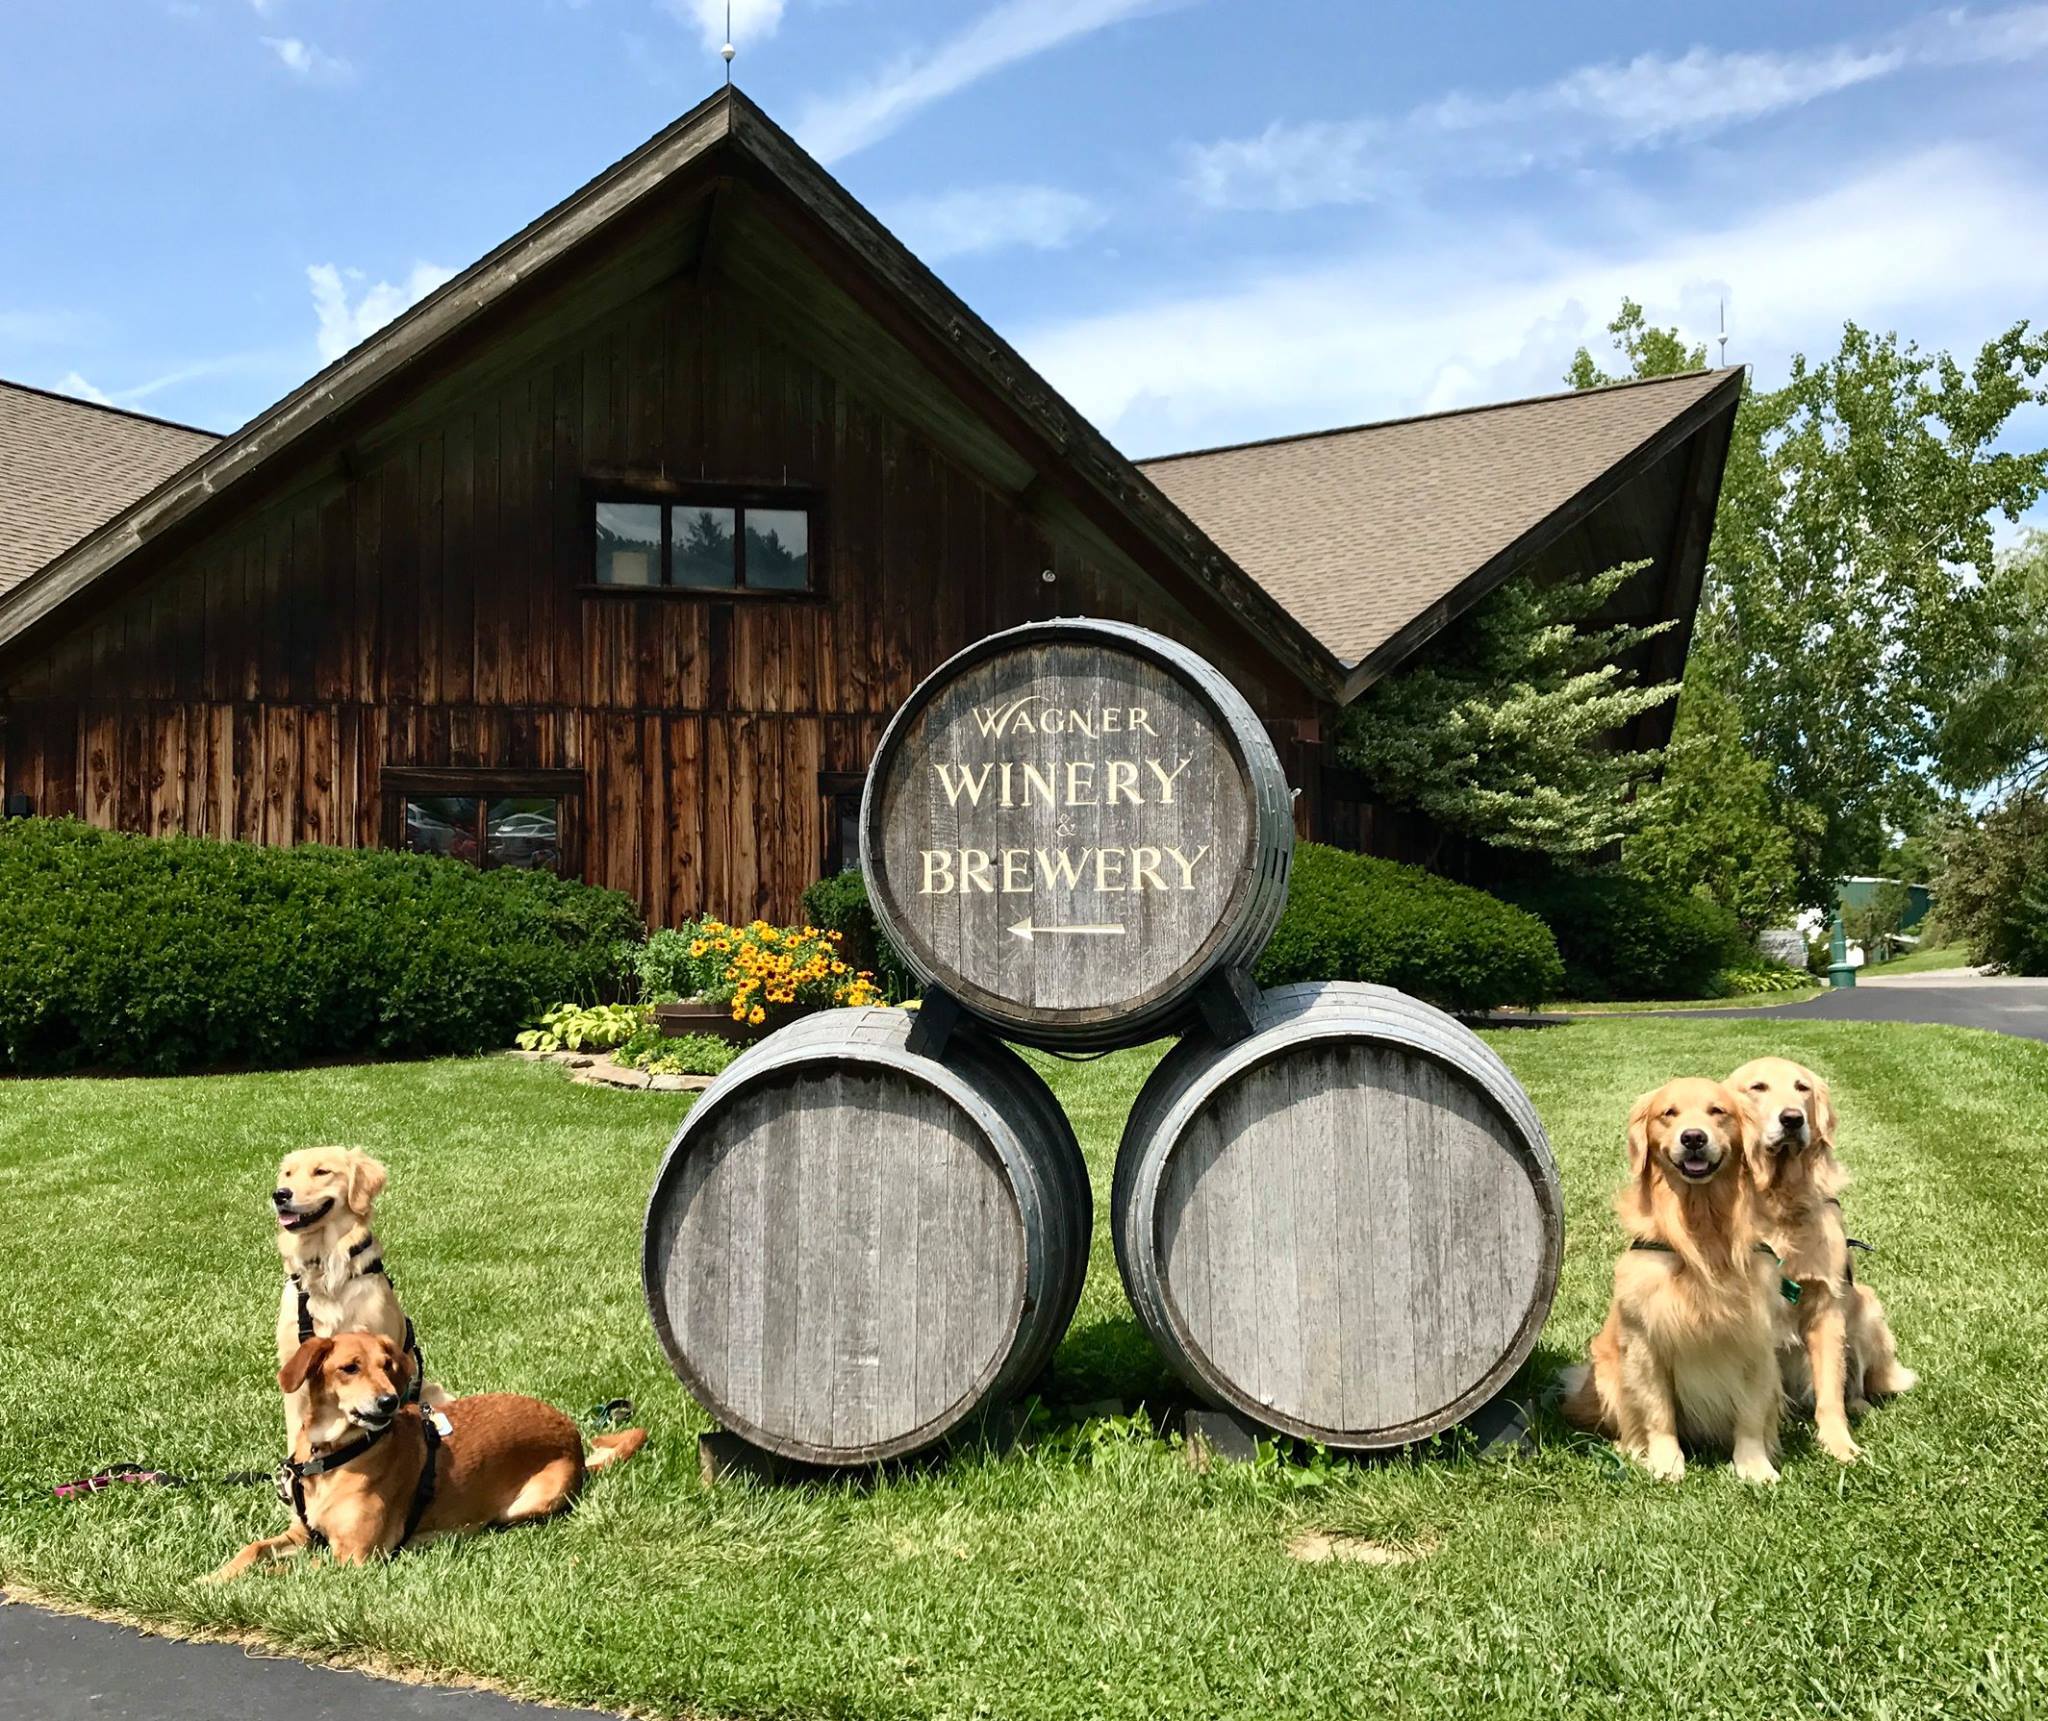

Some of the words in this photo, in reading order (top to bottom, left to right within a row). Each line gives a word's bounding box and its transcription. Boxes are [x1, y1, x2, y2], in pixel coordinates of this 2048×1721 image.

[971, 695, 1159, 739] WAGNER
[934, 755, 1192, 807] WINERY
[1055, 813, 1076, 837] &
[918, 845, 1210, 894] BREWERY
